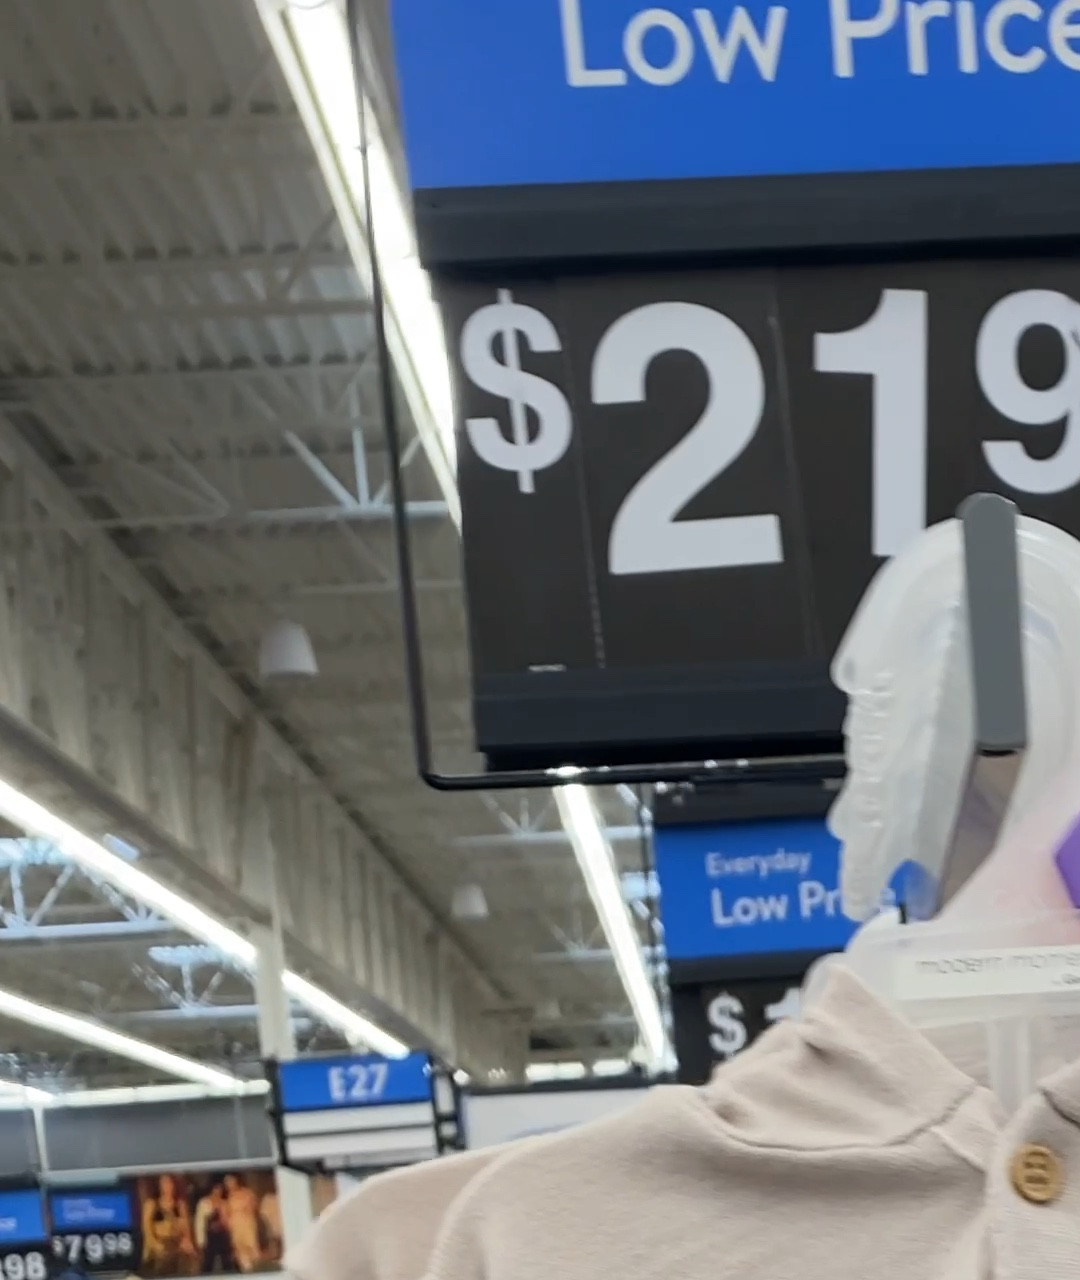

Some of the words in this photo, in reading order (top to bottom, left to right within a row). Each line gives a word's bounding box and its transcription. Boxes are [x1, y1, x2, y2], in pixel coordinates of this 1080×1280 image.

[559, 0, 788, 87] Low
[706, 849, 811, 880] Everyday
[711, 882, 788, 928] Low
[328, 1062, 388, 1103] E27
